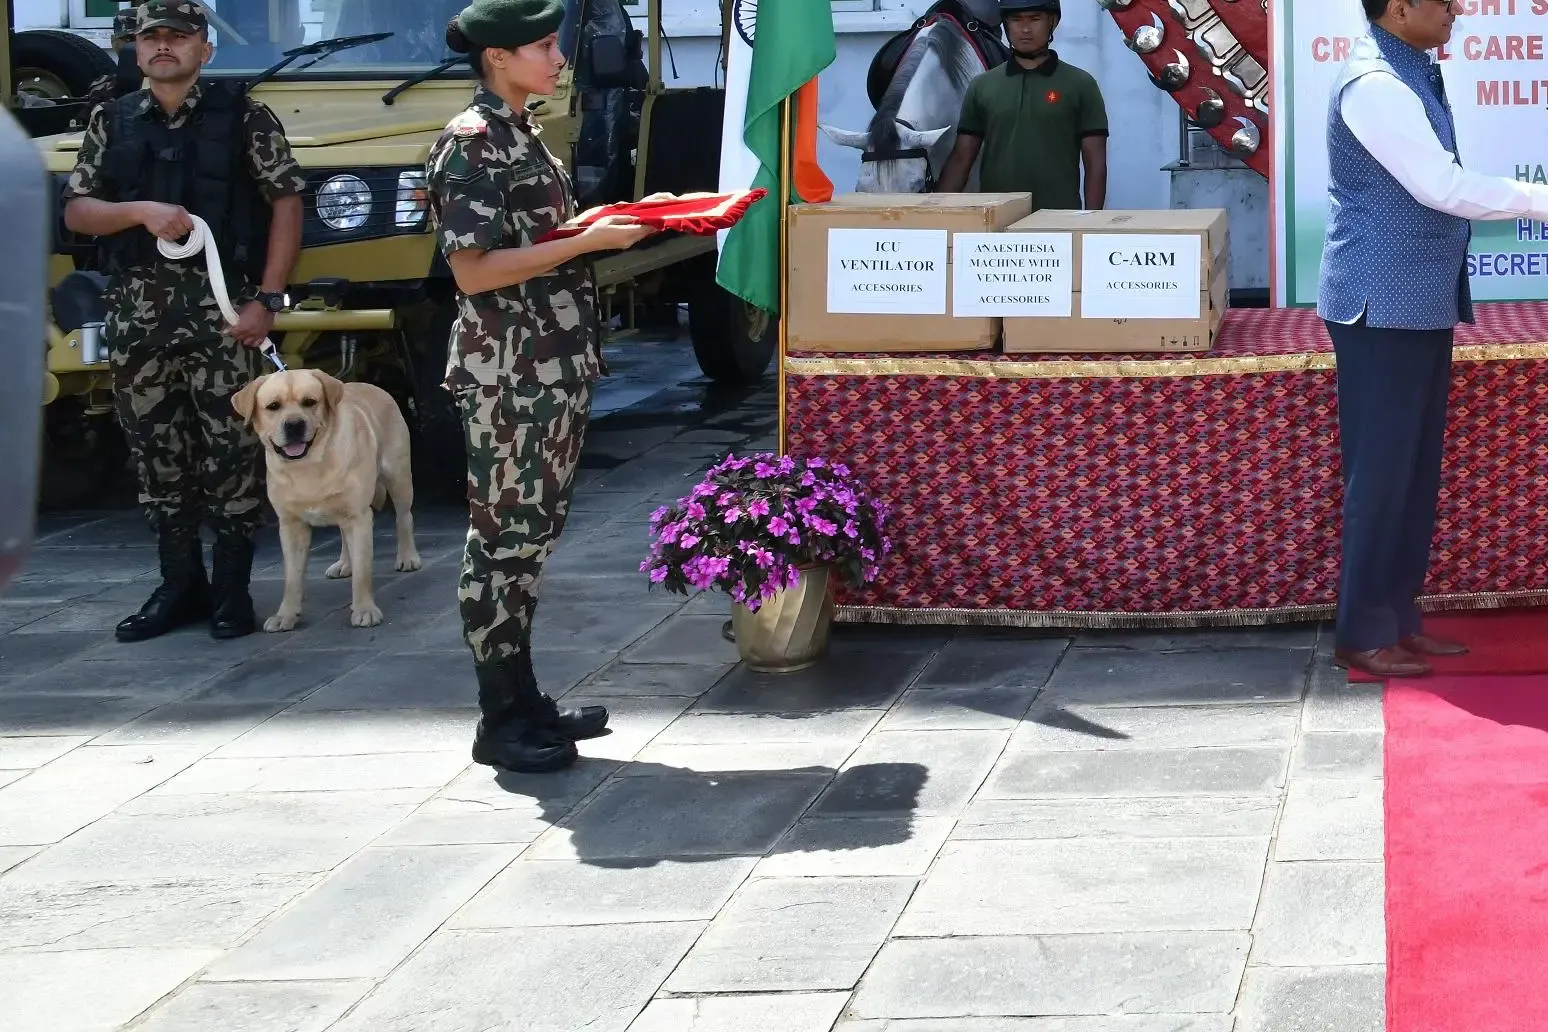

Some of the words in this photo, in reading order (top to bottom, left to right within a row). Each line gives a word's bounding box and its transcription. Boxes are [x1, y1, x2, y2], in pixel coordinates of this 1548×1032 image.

[1463, 35, 1544, 61] CARE
[875, 241, 901, 252] ICU
[974, 243, 1055, 253] ANAESTHESIA
[968, 258, 1025, 268] MACHINE
[1028, 258, 1060, 268] WITH
[1108, 251, 1176, 266] C-ARM
[840, 259, 935, 272] VENTILATOR
[976, 273, 1053, 283] VENTILATOR
[851, 283, 923, 292] ACCESSORIES
[1106, 281, 1178, 290] ACCESSORIES
[978, 295, 1050, 304] ACCESSORIES
